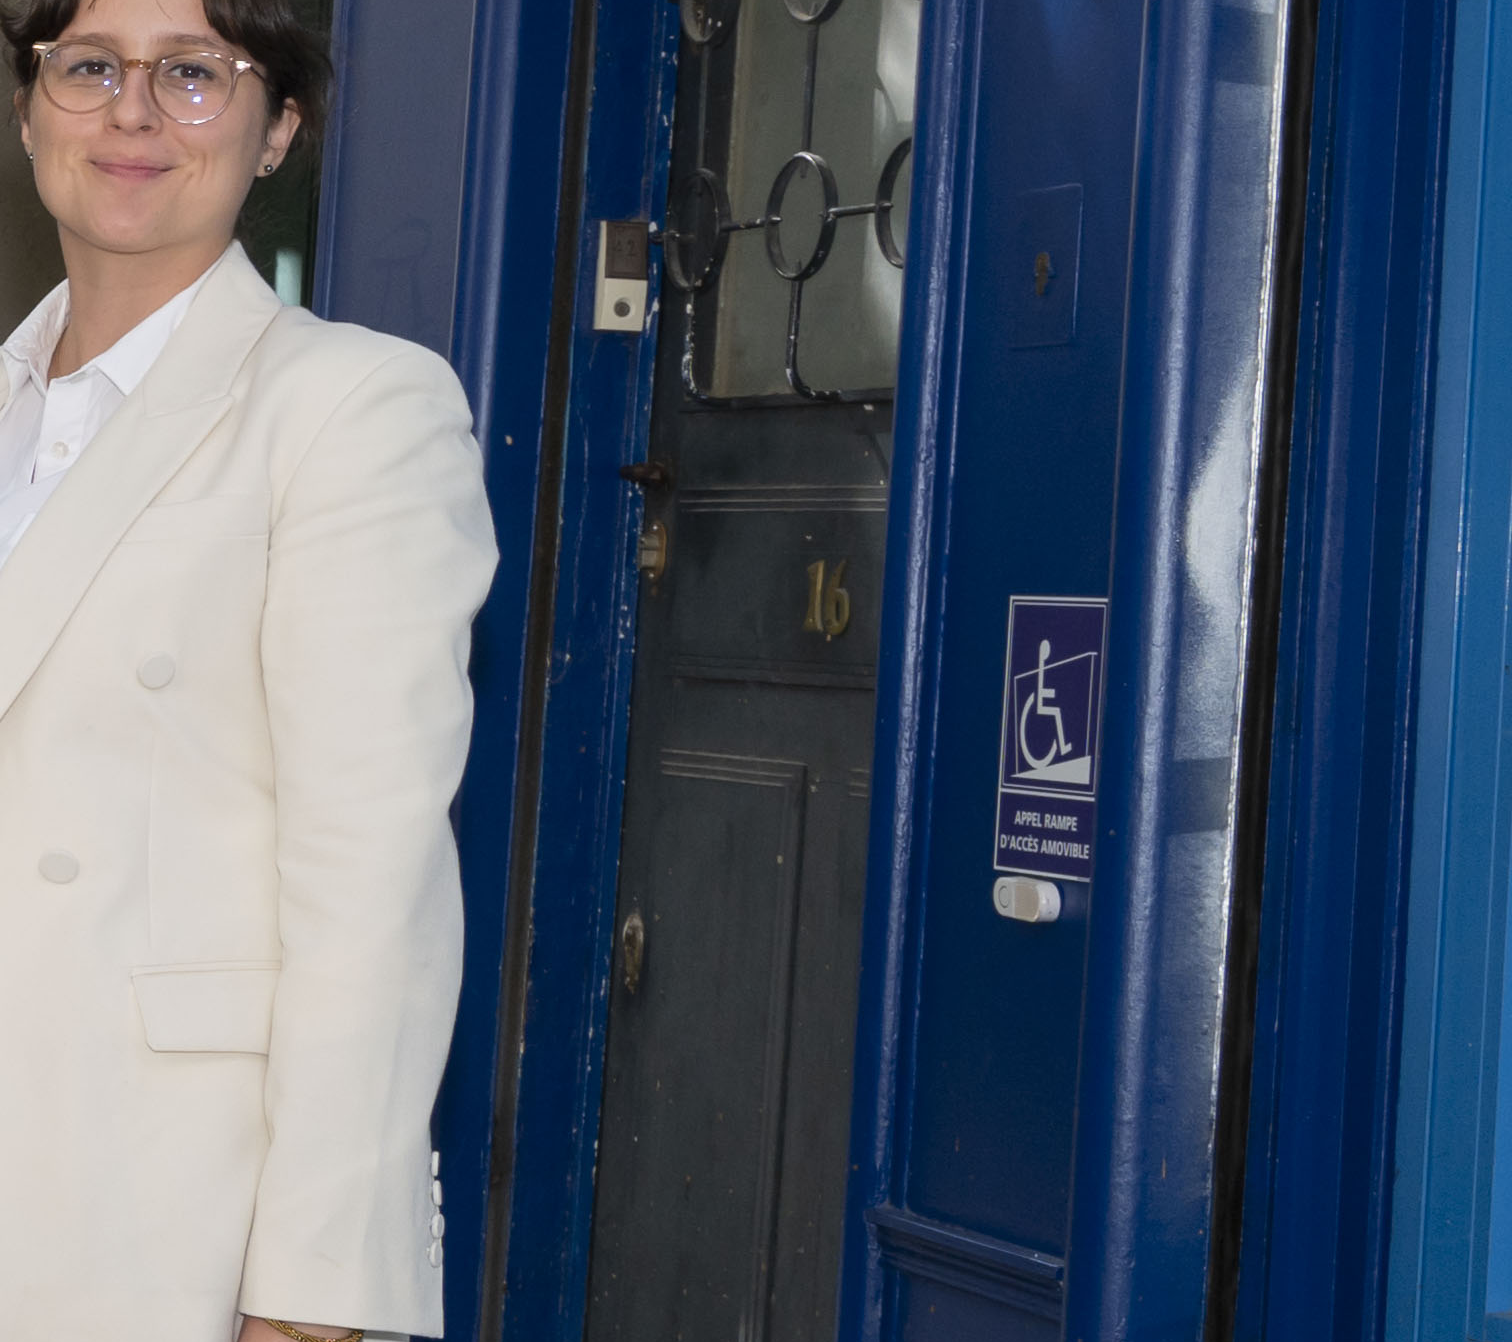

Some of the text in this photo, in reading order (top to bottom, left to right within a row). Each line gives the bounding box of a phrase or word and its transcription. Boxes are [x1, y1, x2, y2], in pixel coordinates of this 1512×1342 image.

[803, 559, 850, 635] 16
[1014, 810, 1078, 832] APPEL RAMPE
[1000, 833, 1090, 859] D'ACCÈS AMOVIBLE
